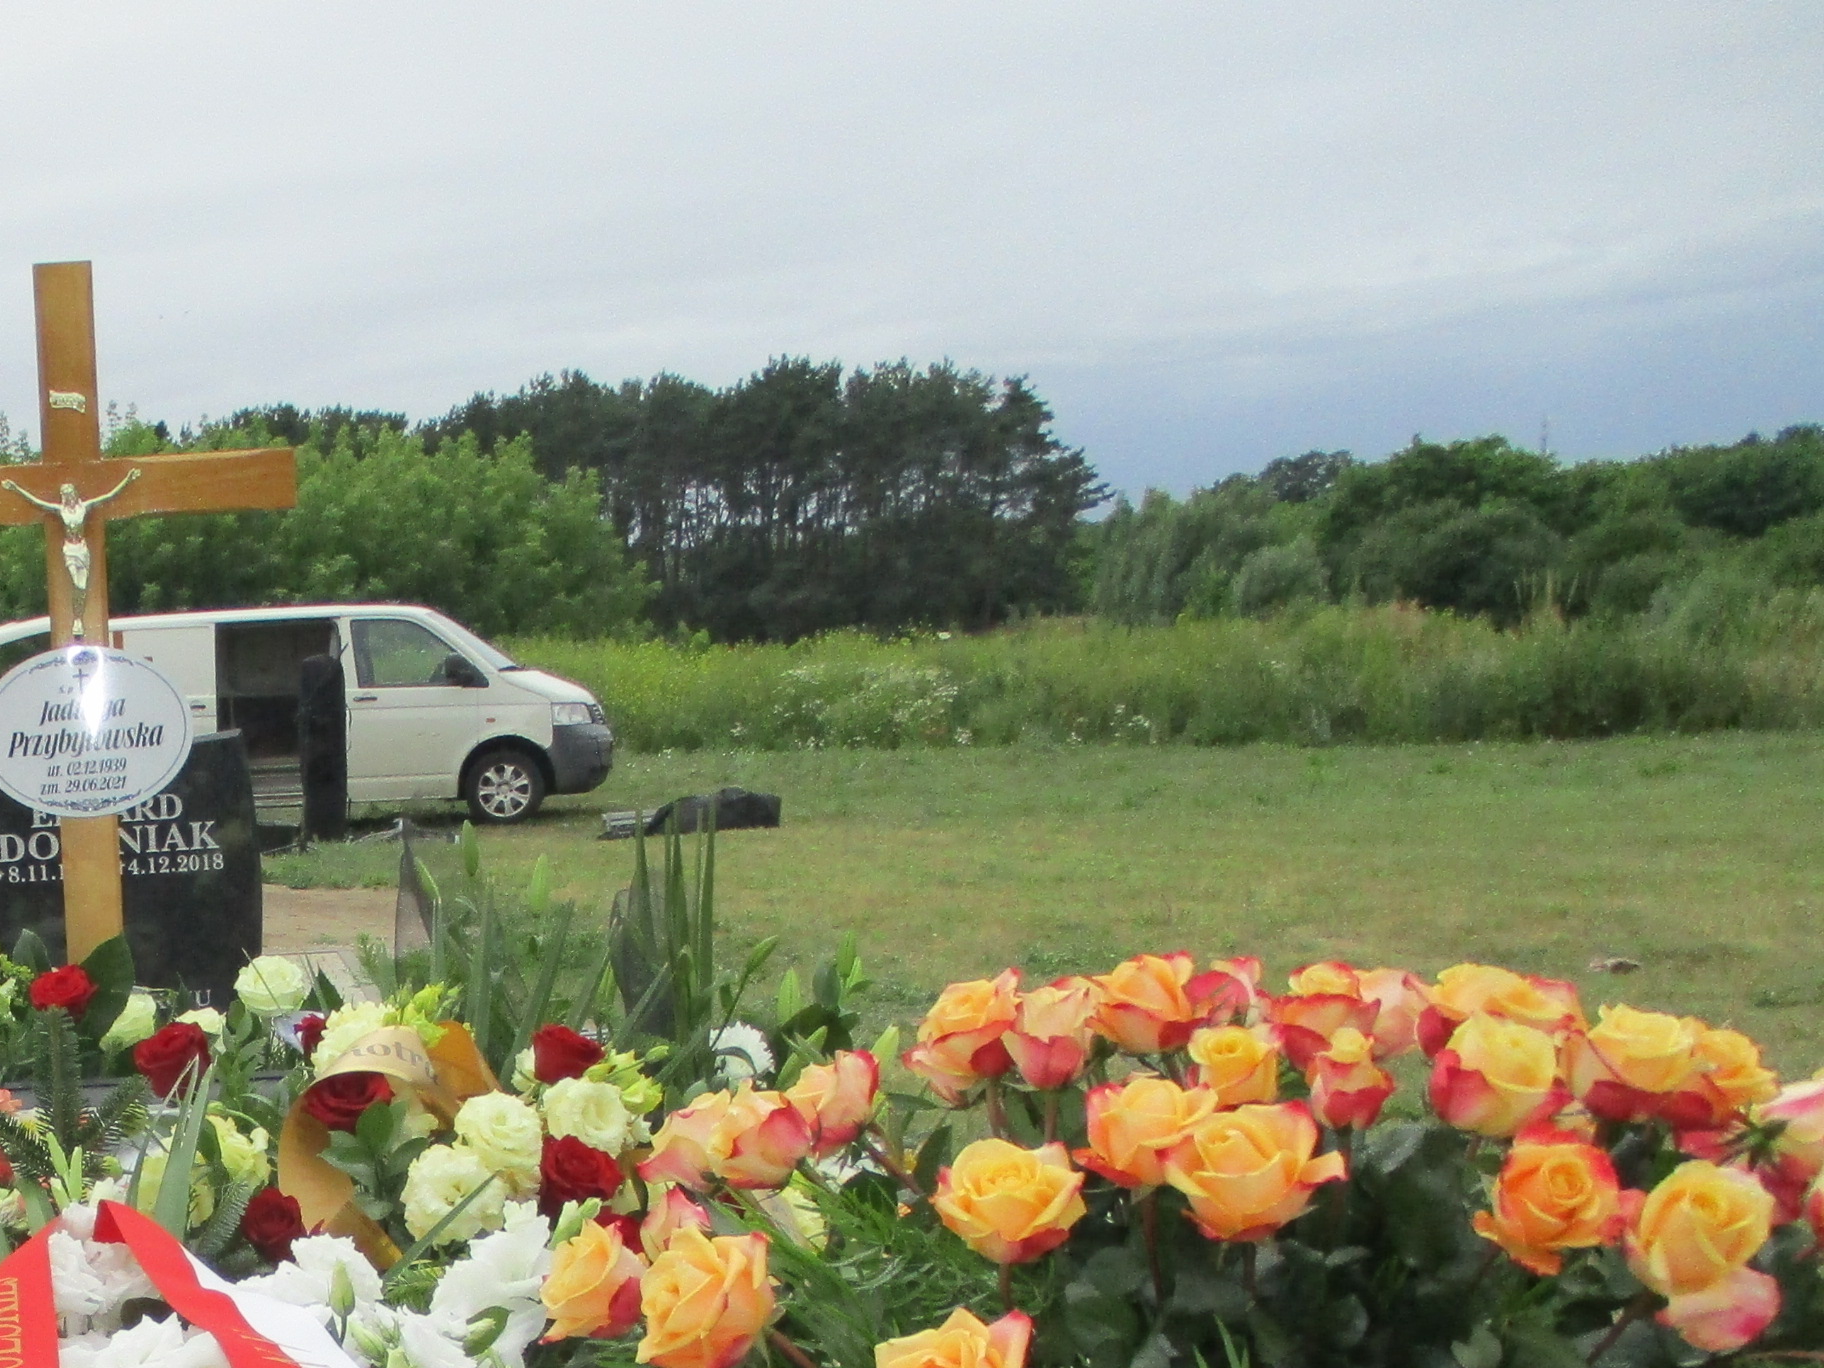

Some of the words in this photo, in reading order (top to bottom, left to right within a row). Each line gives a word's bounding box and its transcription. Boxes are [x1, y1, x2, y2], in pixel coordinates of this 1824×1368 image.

[67, 758, 127, 776] 02.12.1939
[65, 776, 127, 793] 29.06.2021
[127, 853, 224, 875] 4.12.2018
